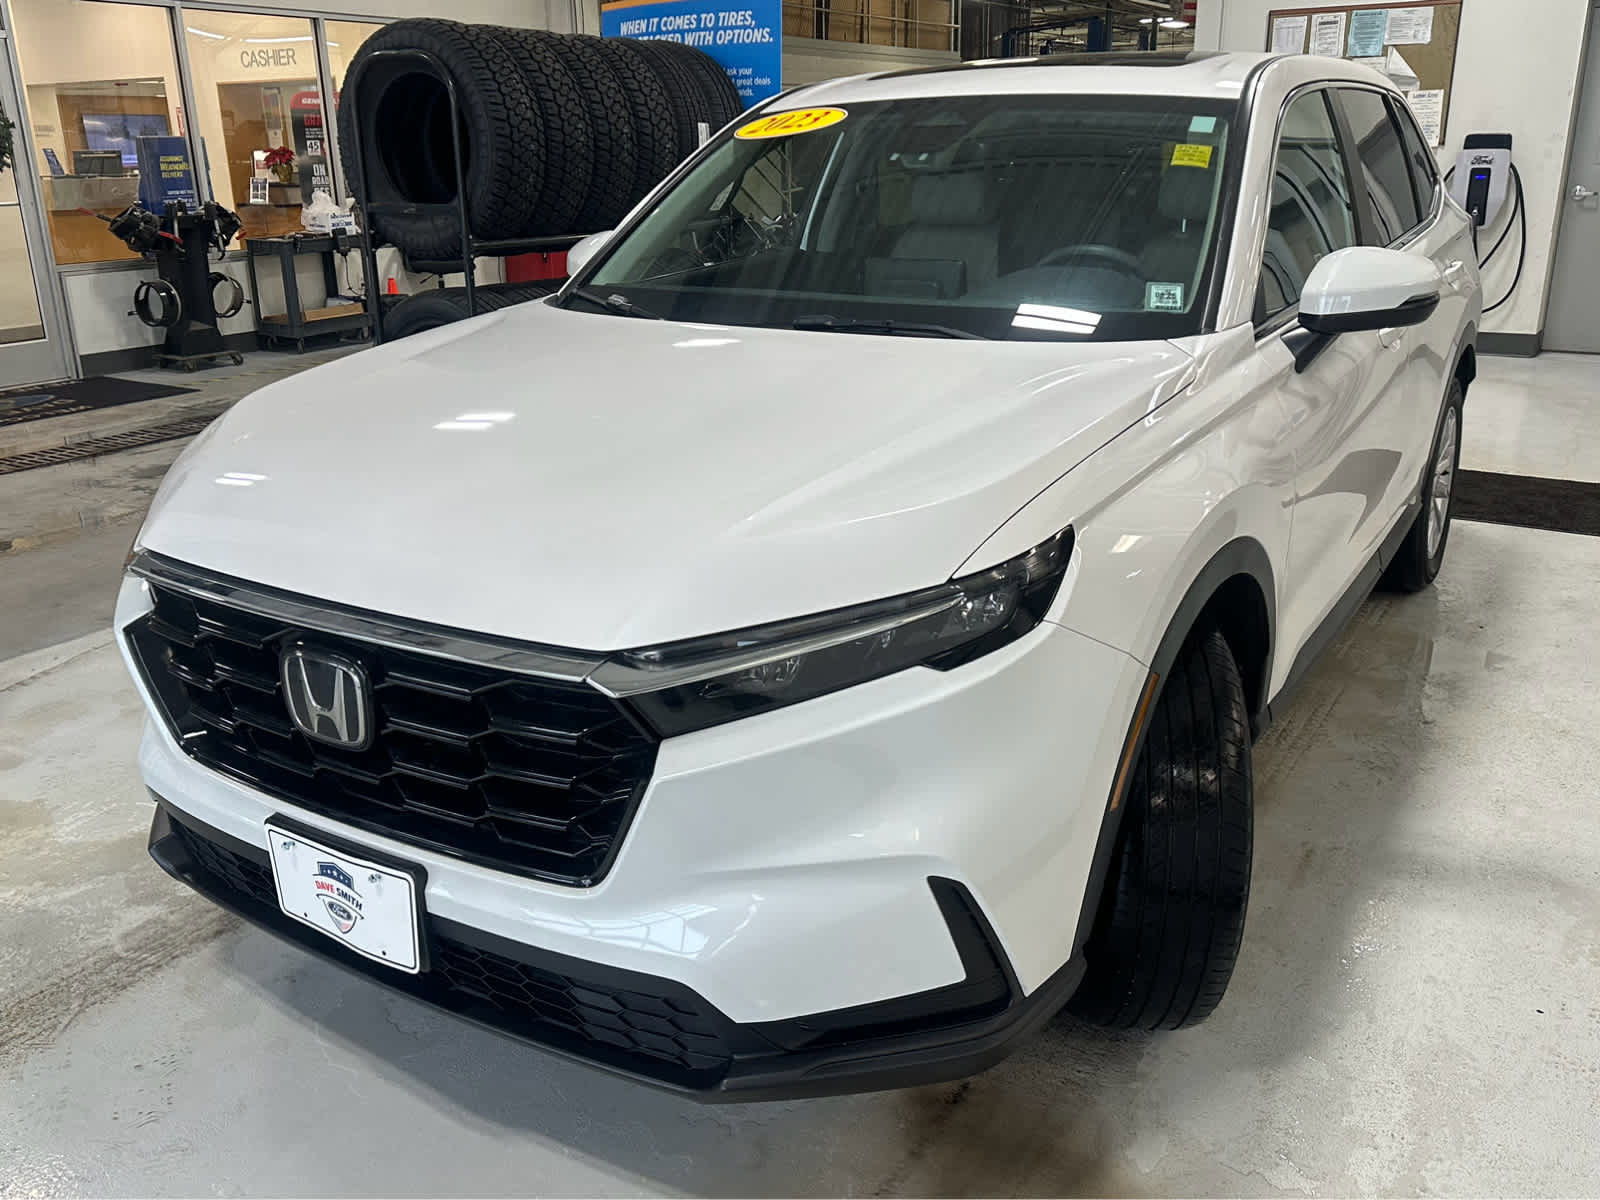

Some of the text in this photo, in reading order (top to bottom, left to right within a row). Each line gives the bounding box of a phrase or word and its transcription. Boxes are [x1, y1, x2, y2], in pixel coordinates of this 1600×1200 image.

[620, 10, 756, 36] WHEN IT COMES TO TIRES,
[684, 31, 713, 46] WITH
[716, 27, 774, 45] OPTIONS.
[240, 48, 297, 68] CASHIER
[736, 75, 772, 88] great deals
[738, 67, 753, 77] your
[743, 111, 832, 136] 2023
[315, 880, 363, 911] DAVE SMITH
